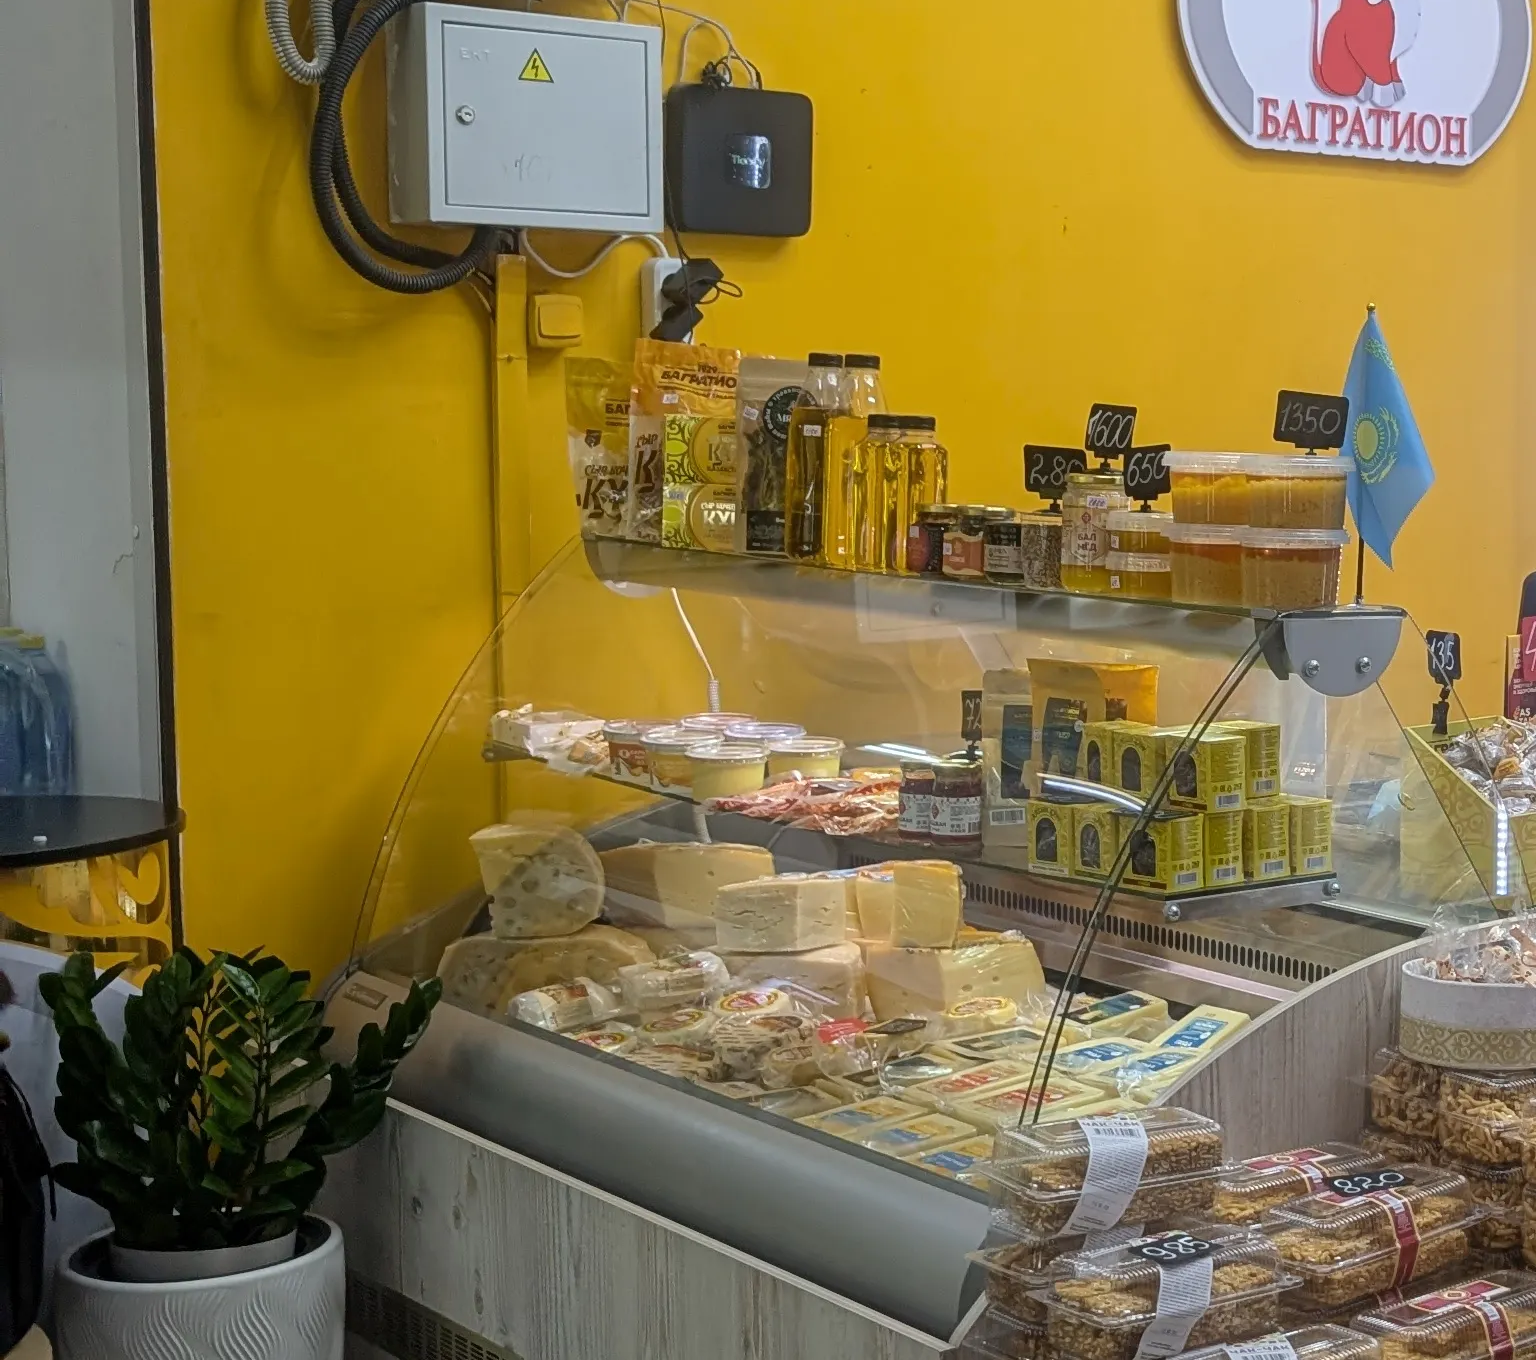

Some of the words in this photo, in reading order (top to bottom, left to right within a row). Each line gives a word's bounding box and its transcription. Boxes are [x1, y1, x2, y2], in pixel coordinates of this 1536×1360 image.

[1257, 97, 1468, 157] БАГРАТИОН
[660, 370, 737, 389] БАГРАТИО
[1088, 409, 1134, 449] 1600
[1279, 400, 1341, 435] 1350
[1126, 450, 1168, 487] 650
[1429, 638, 1455, 672] 135
[1333, 1171, 1405, 1194] 820
[1141, 1236, 1210, 1260] 985
